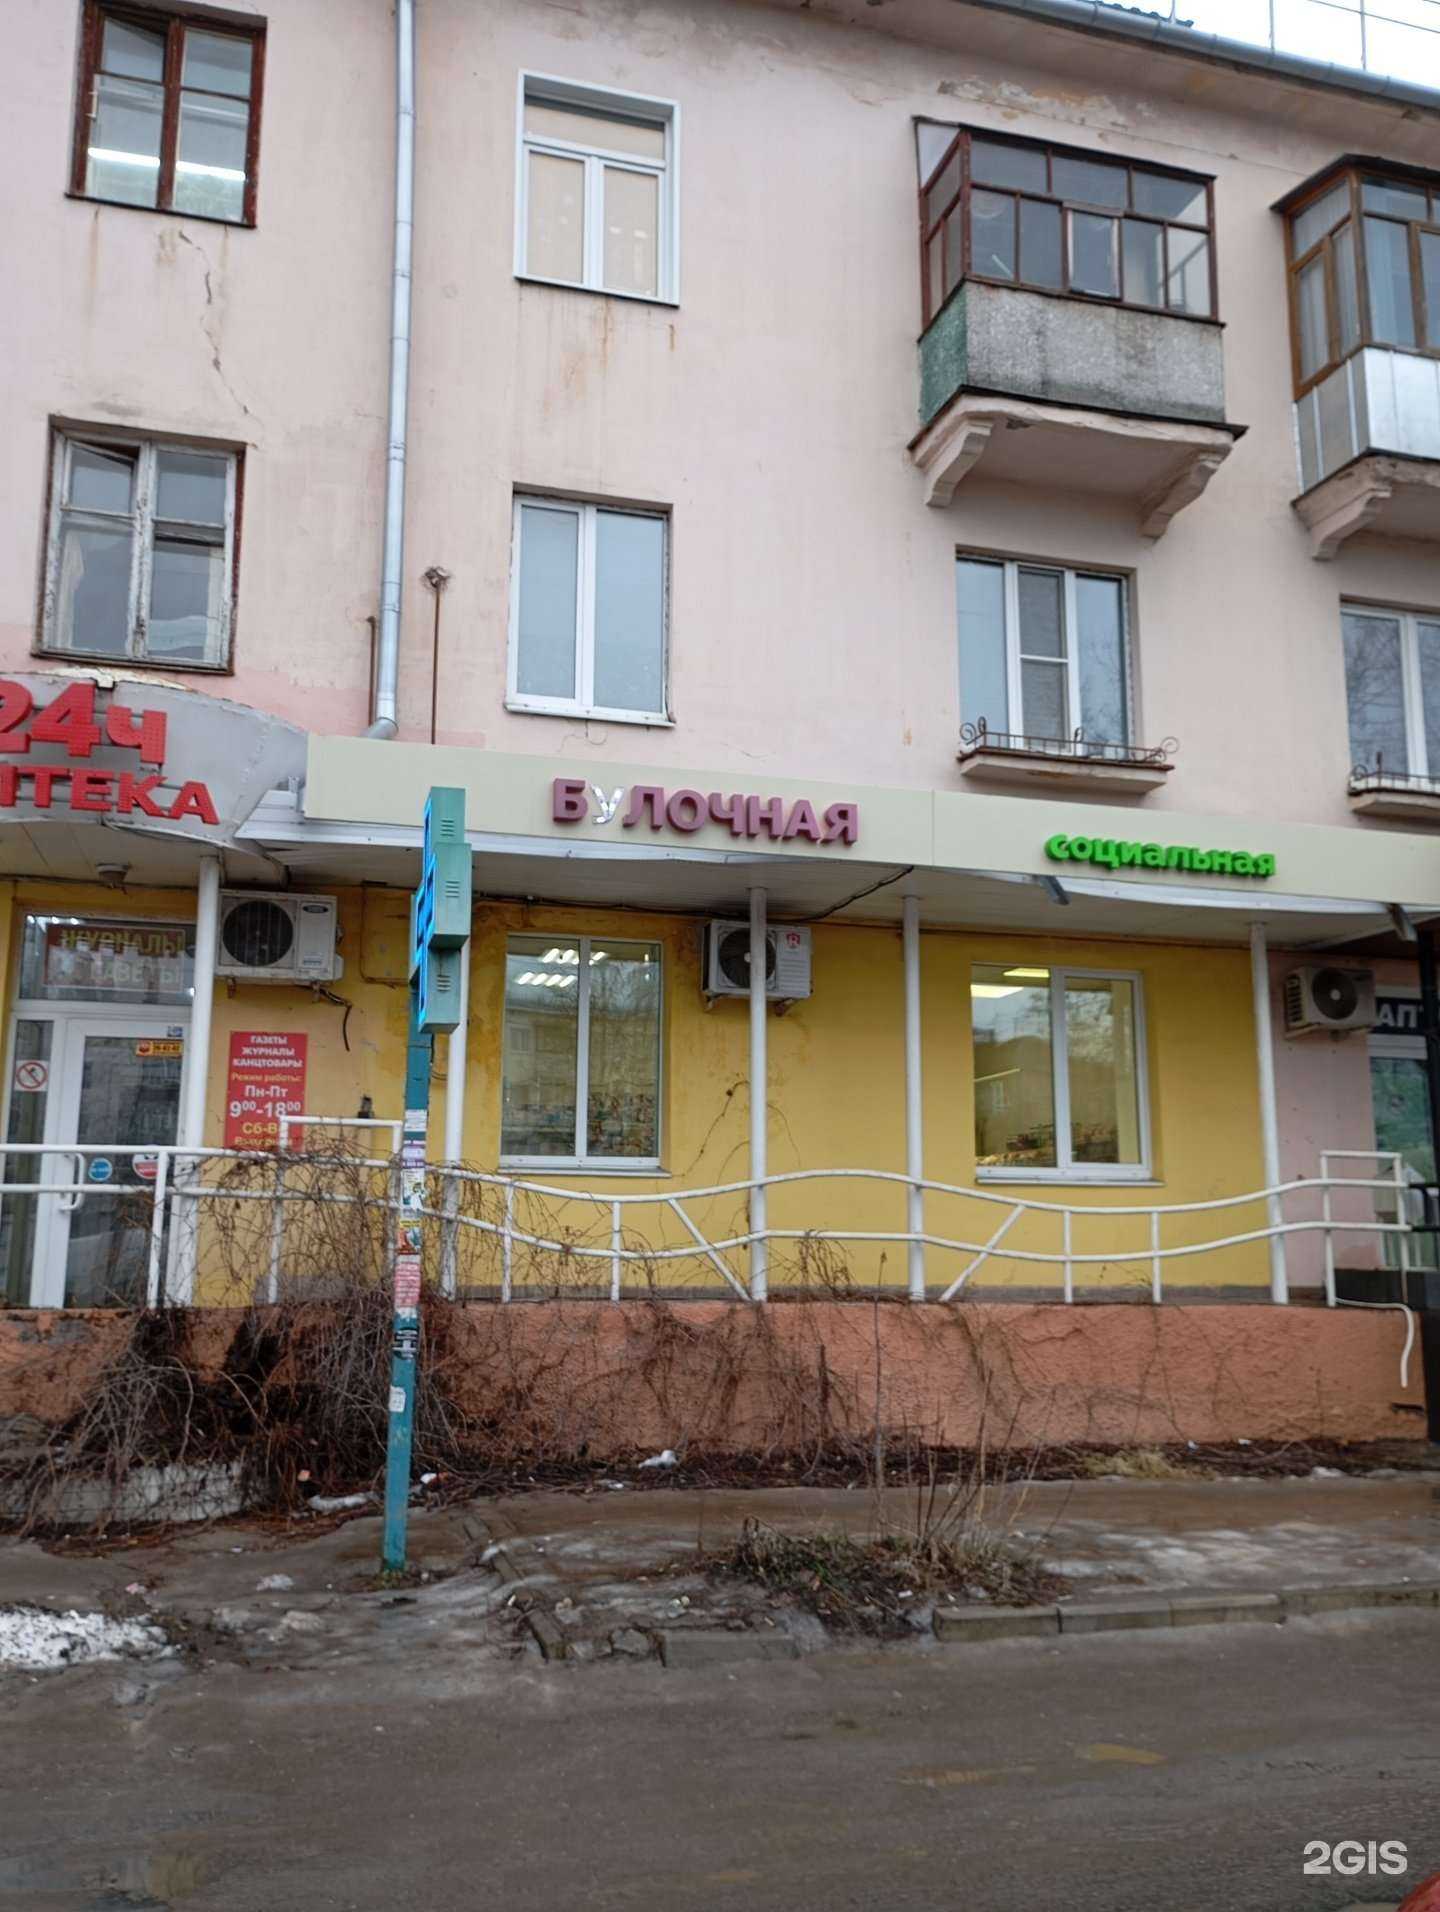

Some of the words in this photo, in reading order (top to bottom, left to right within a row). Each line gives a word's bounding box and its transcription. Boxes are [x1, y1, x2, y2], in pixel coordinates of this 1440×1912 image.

[552, 777, 859, 847] БУЛОЧНАЯ
[1044, 834, 1276, 878] социальная
[250, 1035, 288, 1044] ГАЗЕТЫ
[241, 1046, 295, 1056] ЖУРНАЛЫ
[232, 1058, 304, 1068] КАНЦТОВАРЫ
[245, 1084, 289, 1097] Пн-Пт
